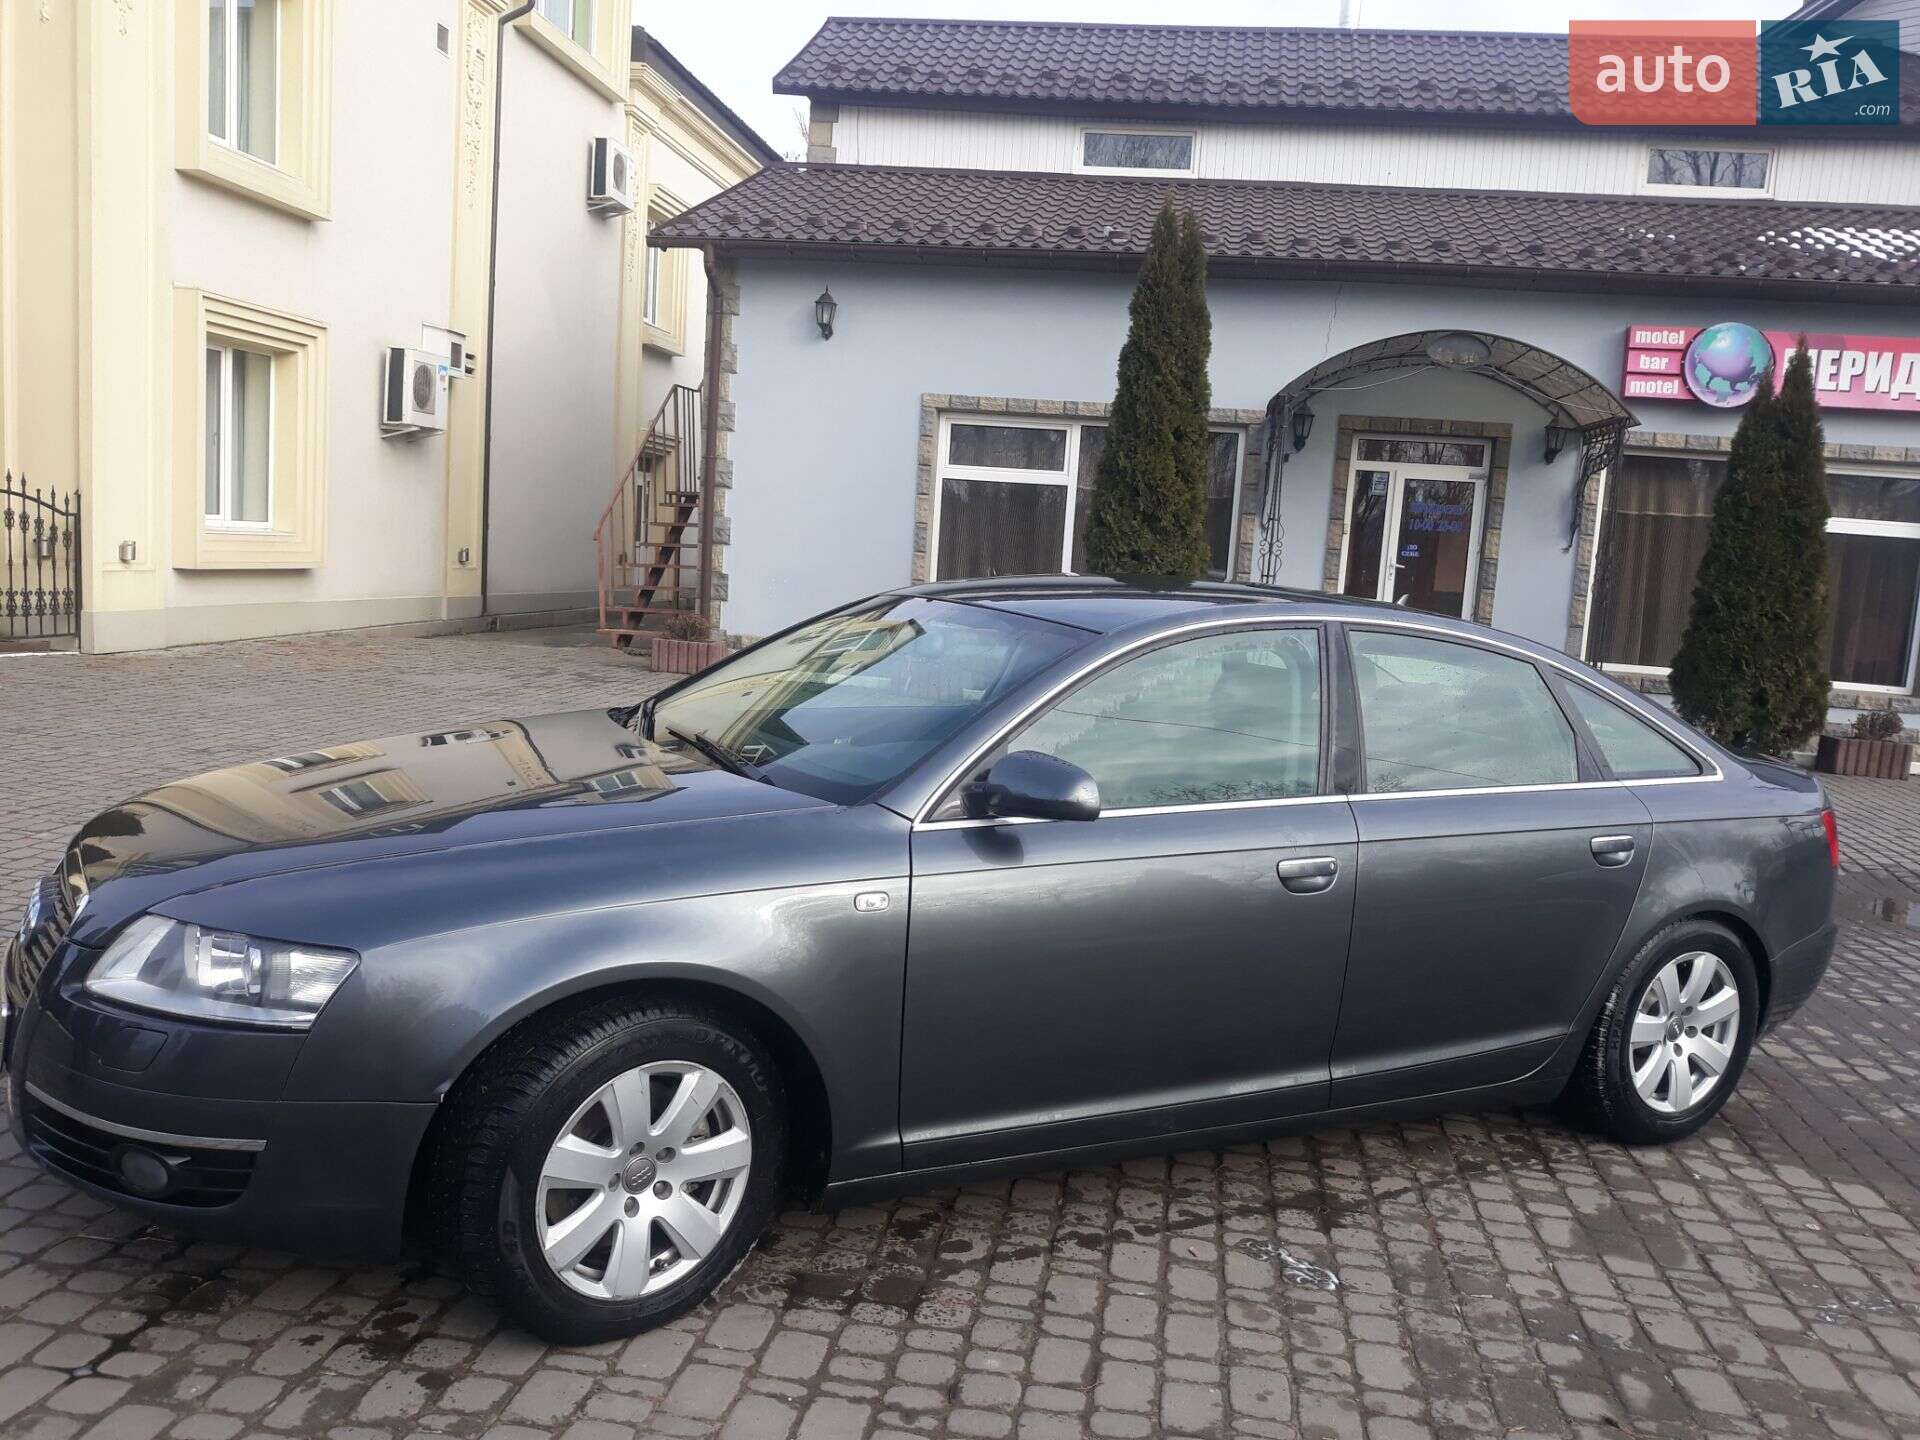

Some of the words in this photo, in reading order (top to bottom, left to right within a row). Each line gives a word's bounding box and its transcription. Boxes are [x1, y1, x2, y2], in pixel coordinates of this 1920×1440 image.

[1635, 330, 1686, 345] motel
[1639, 353, 1669, 370] bar
[1629, 379, 1679, 395] motel
